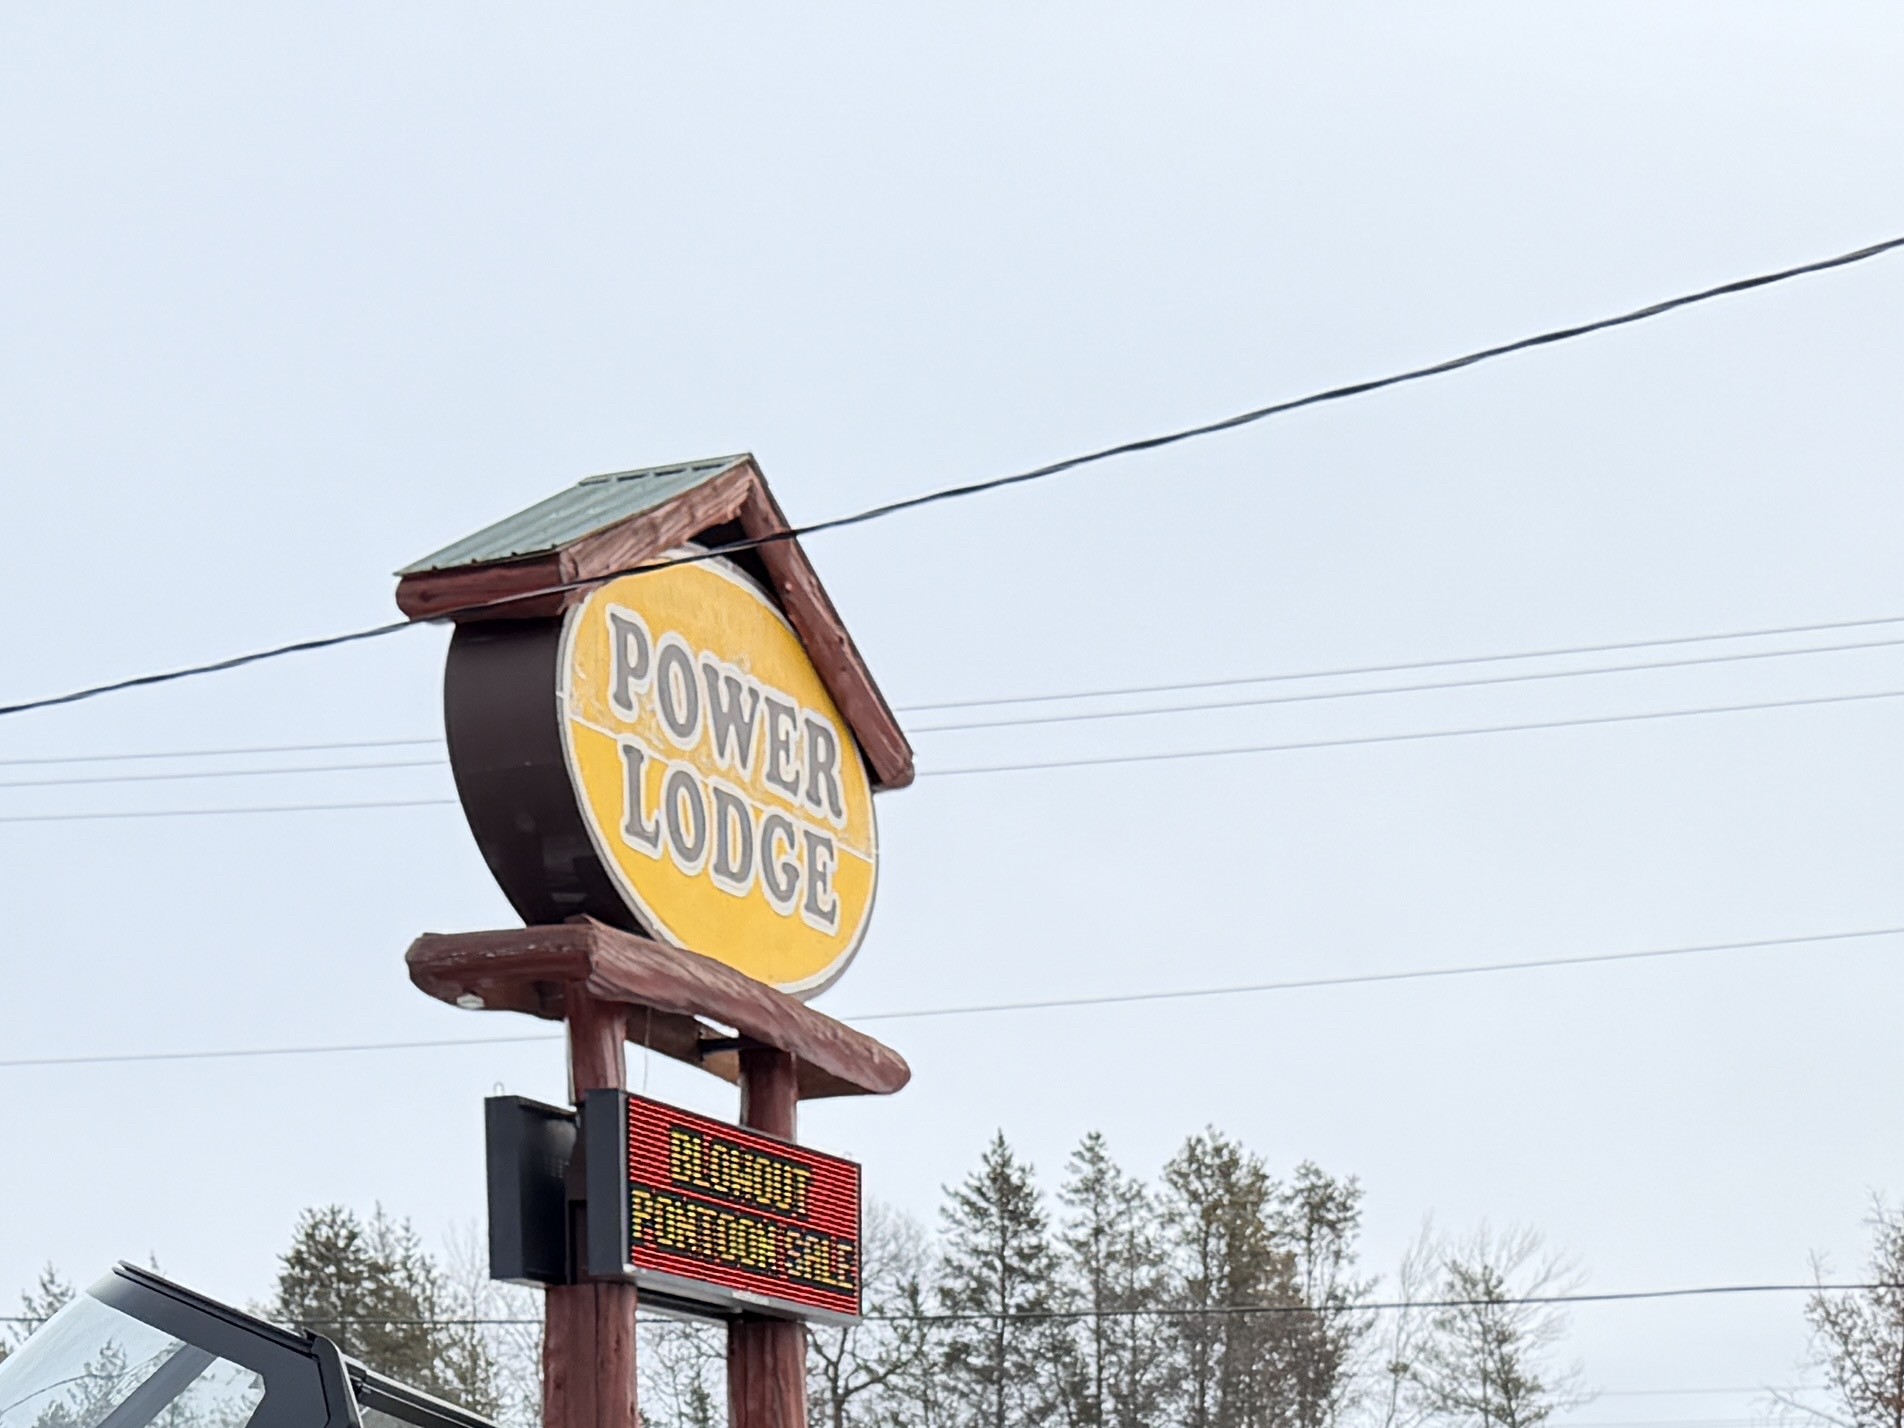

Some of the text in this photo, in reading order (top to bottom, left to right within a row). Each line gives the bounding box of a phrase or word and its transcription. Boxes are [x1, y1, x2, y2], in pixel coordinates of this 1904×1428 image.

[610, 608, 843, 820] POWER
[623, 744, 839, 931] LODGE
[632, 1189, 854, 1289] PONTOON SALE
